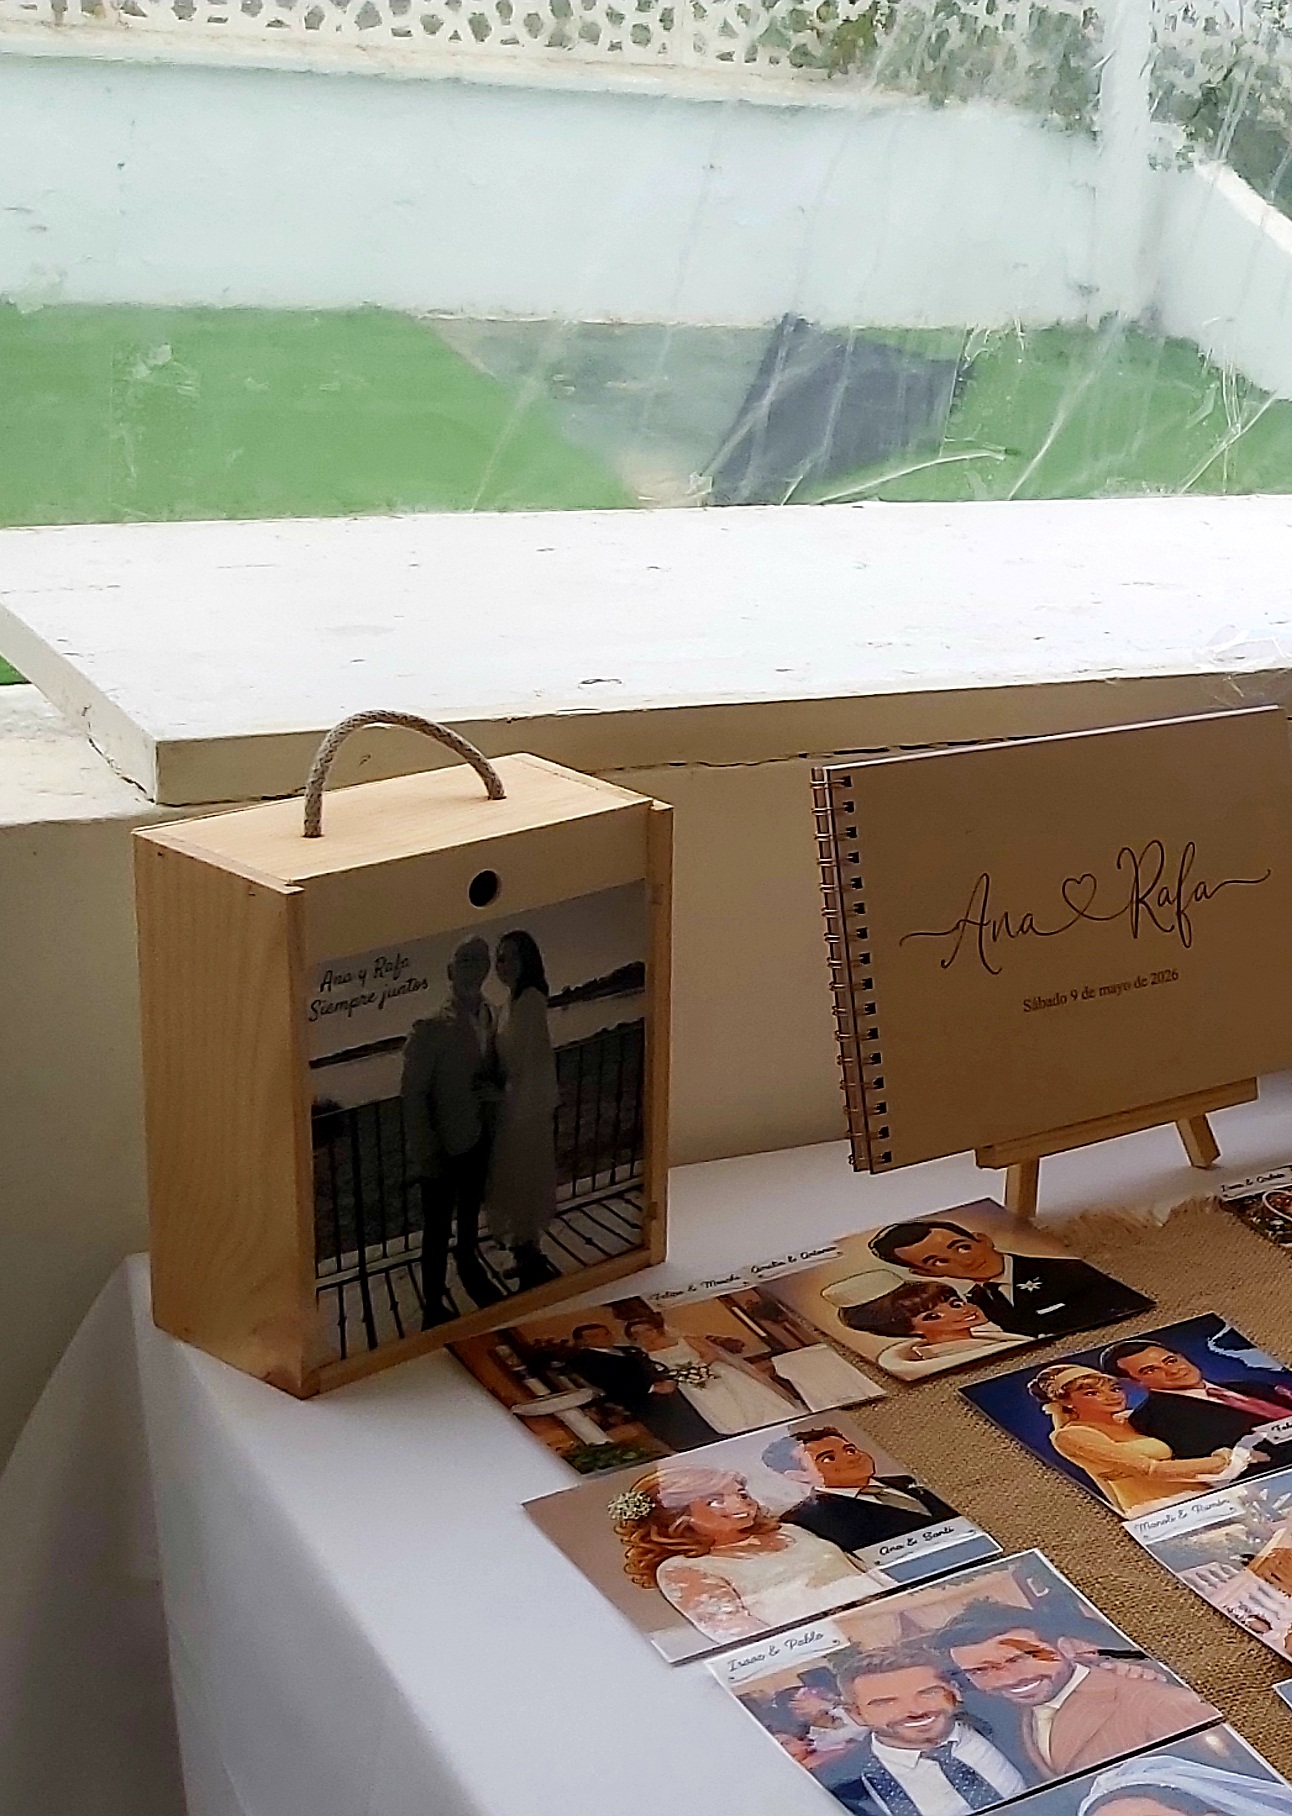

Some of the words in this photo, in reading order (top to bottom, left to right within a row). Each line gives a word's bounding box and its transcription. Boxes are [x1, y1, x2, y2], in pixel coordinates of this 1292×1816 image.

[930, 872, 1045, 976] Ana
[1115, 839, 1228, 949] Rafa
[319, 970, 352, 993] Ana
[373, 953, 409, 981] Rafa
[1022, 991, 1068, 1013] Sábado
[1070, 989, 1079, 1002] 9
[1081, 985, 1096, 1000] de
[1098, 980, 1132, 999] mayo
[1133, 975, 1149, 989] de
[1150, 967, 1179, 985] 2026
[308, 990, 376, 1022] Siempre
[378, 976, 429, 1010] juntos
